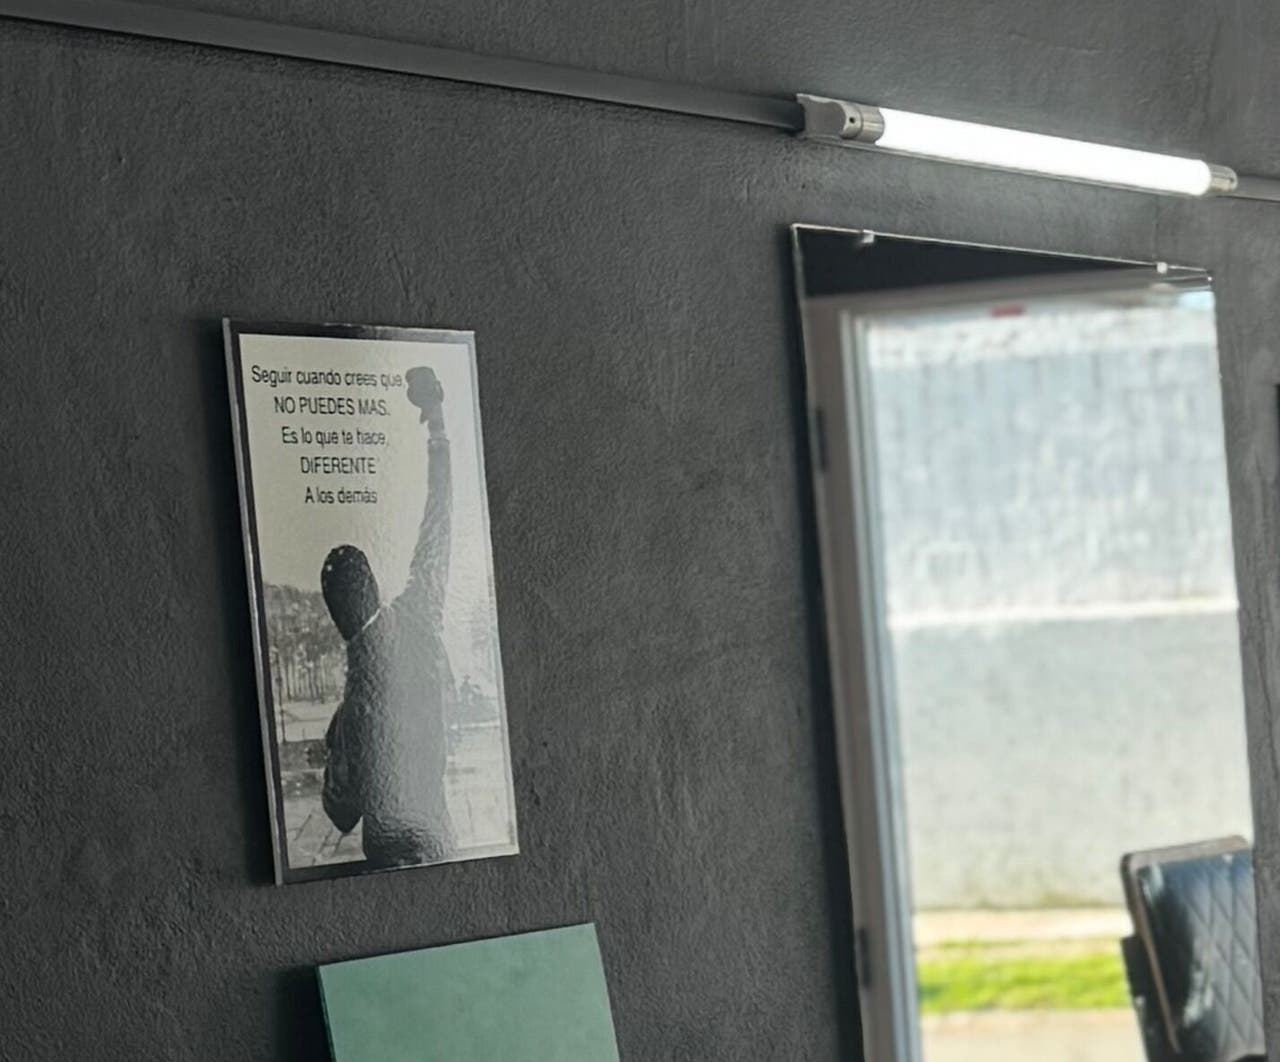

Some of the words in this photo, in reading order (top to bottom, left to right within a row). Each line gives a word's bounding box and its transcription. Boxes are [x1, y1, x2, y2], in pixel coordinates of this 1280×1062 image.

[251, 365, 292, 388] Seguir
[296, 368, 341, 386] cuando
[345, 371, 377, 387] crees
[274, 396, 296, 414] NO
[299, 396, 355, 415] PUEDES
[282, 426, 298, 444] Es
[301, 427, 312, 444] lo
[316, 430, 338, 449] que
[342, 429, 353, 444] te
[300, 456, 376, 474] DIFERENTE
[305, 486, 314, 503] A
[316, 487, 334, 504] los
